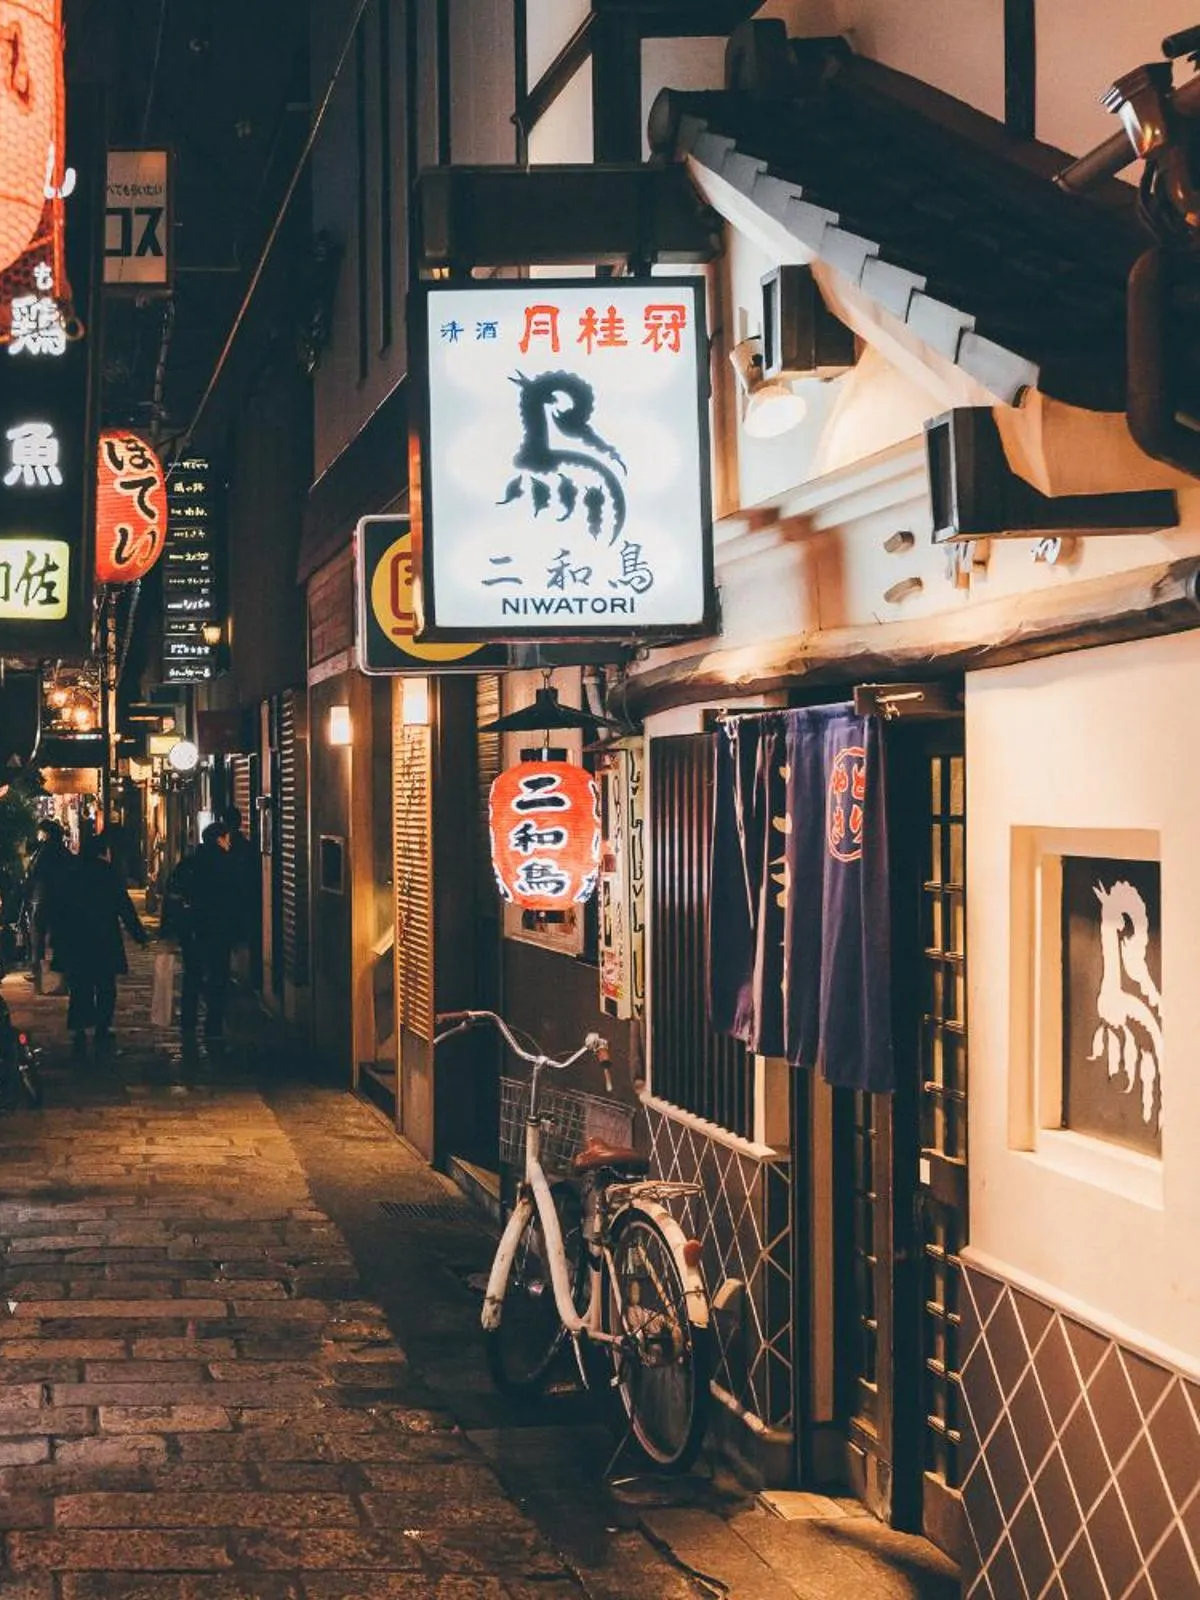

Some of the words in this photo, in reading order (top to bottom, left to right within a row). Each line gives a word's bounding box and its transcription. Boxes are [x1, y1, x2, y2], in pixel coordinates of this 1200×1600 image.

[439, 320, 499, 343] 清酒
[517, 303, 687, 355] 月桂冠
[105, 437, 158, 566] ほてい
[481, 541, 655, 594] 二和鳥
[502, 597, 636, 615] NIWATORI
[513, 775, 567, 895] 二和鳥
